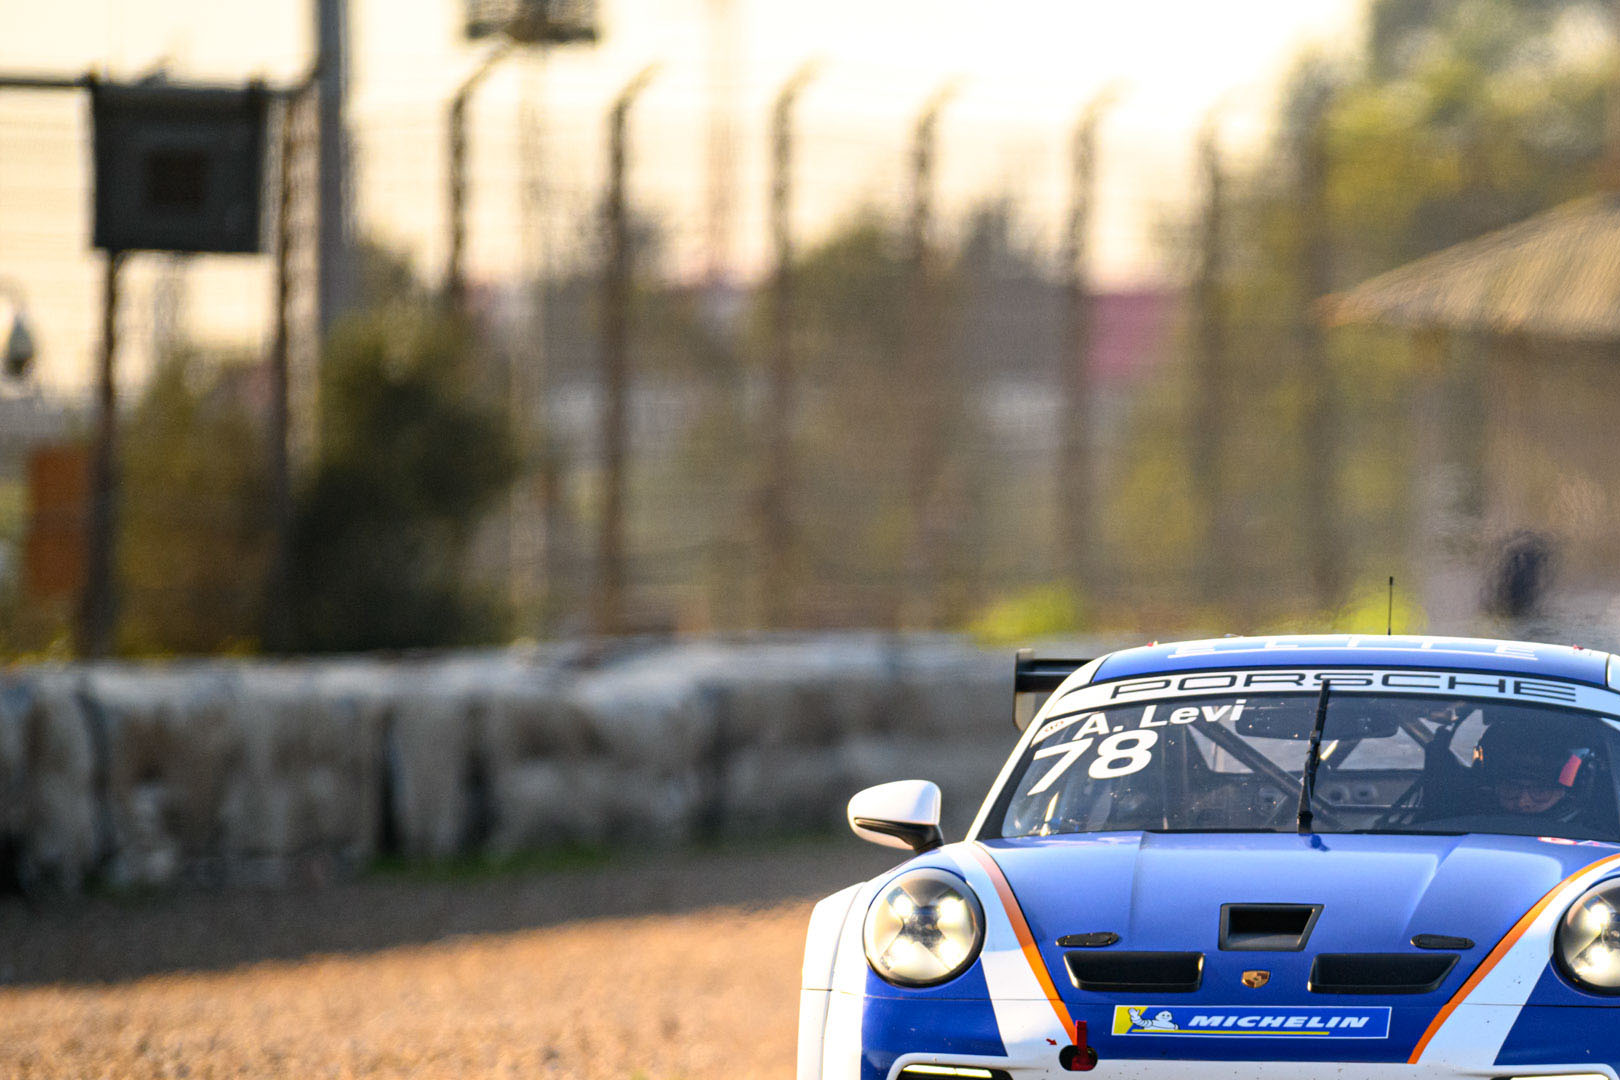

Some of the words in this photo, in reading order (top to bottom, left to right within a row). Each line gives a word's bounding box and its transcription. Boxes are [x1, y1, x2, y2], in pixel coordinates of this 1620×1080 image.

[1110, 672, 1576, 702] PORSCHE
[1072, 711, 1124, 741] A.
[1139, 699, 1247, 728] Levi
[1027, 728, 1159, 797] 78
[1188, 1015, 1370, 1029] MICHELIN
